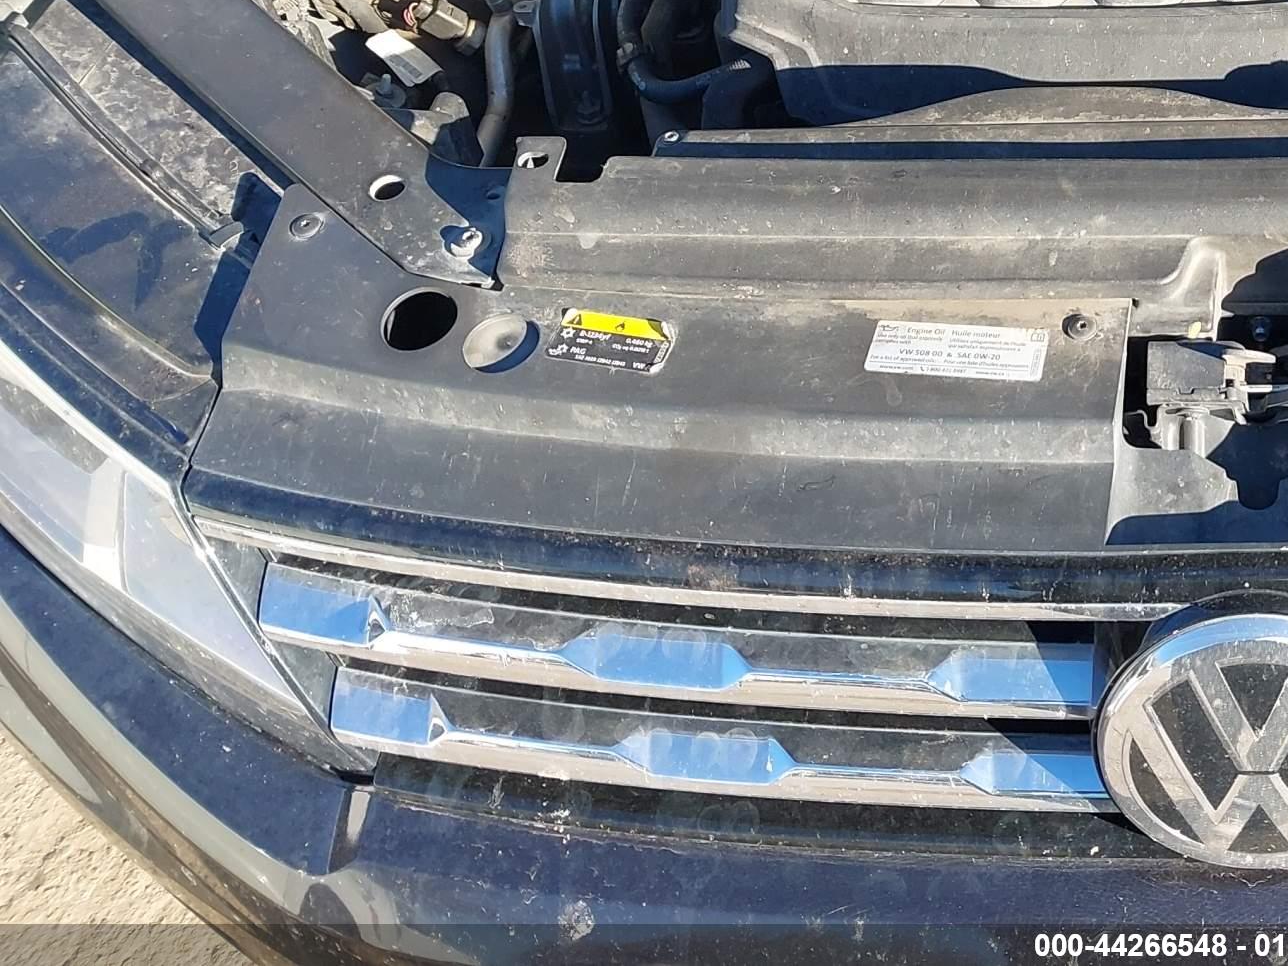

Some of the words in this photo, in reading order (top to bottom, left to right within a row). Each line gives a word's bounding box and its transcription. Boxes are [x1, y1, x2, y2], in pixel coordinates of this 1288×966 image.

[907, 327, 932, 336] Engine
[952, 329, 971, 337] Huile
[973, 330, 1001, 338] moteur
[570, 346, 587, 355] PAG
[632, 361, 646, 370] VW
